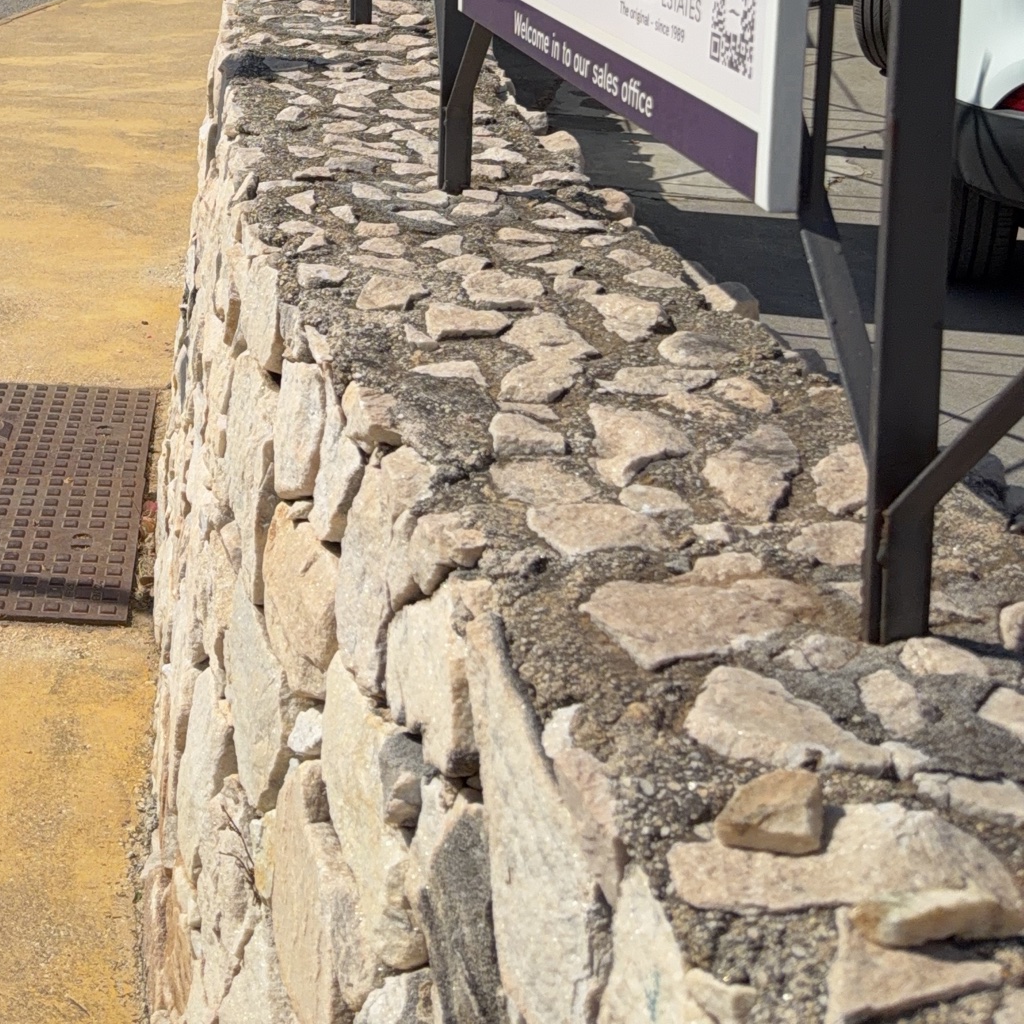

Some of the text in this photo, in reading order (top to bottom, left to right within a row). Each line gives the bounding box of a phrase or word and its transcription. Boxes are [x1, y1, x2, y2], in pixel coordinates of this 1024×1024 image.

[619, 0, 630, 17] The
[629, 7, 650, 27] original
[654, 18, 670, 37] since
[670, 24, 685, 44] 1989
[513, 10, 654, 118] Welcome in to our sales office
